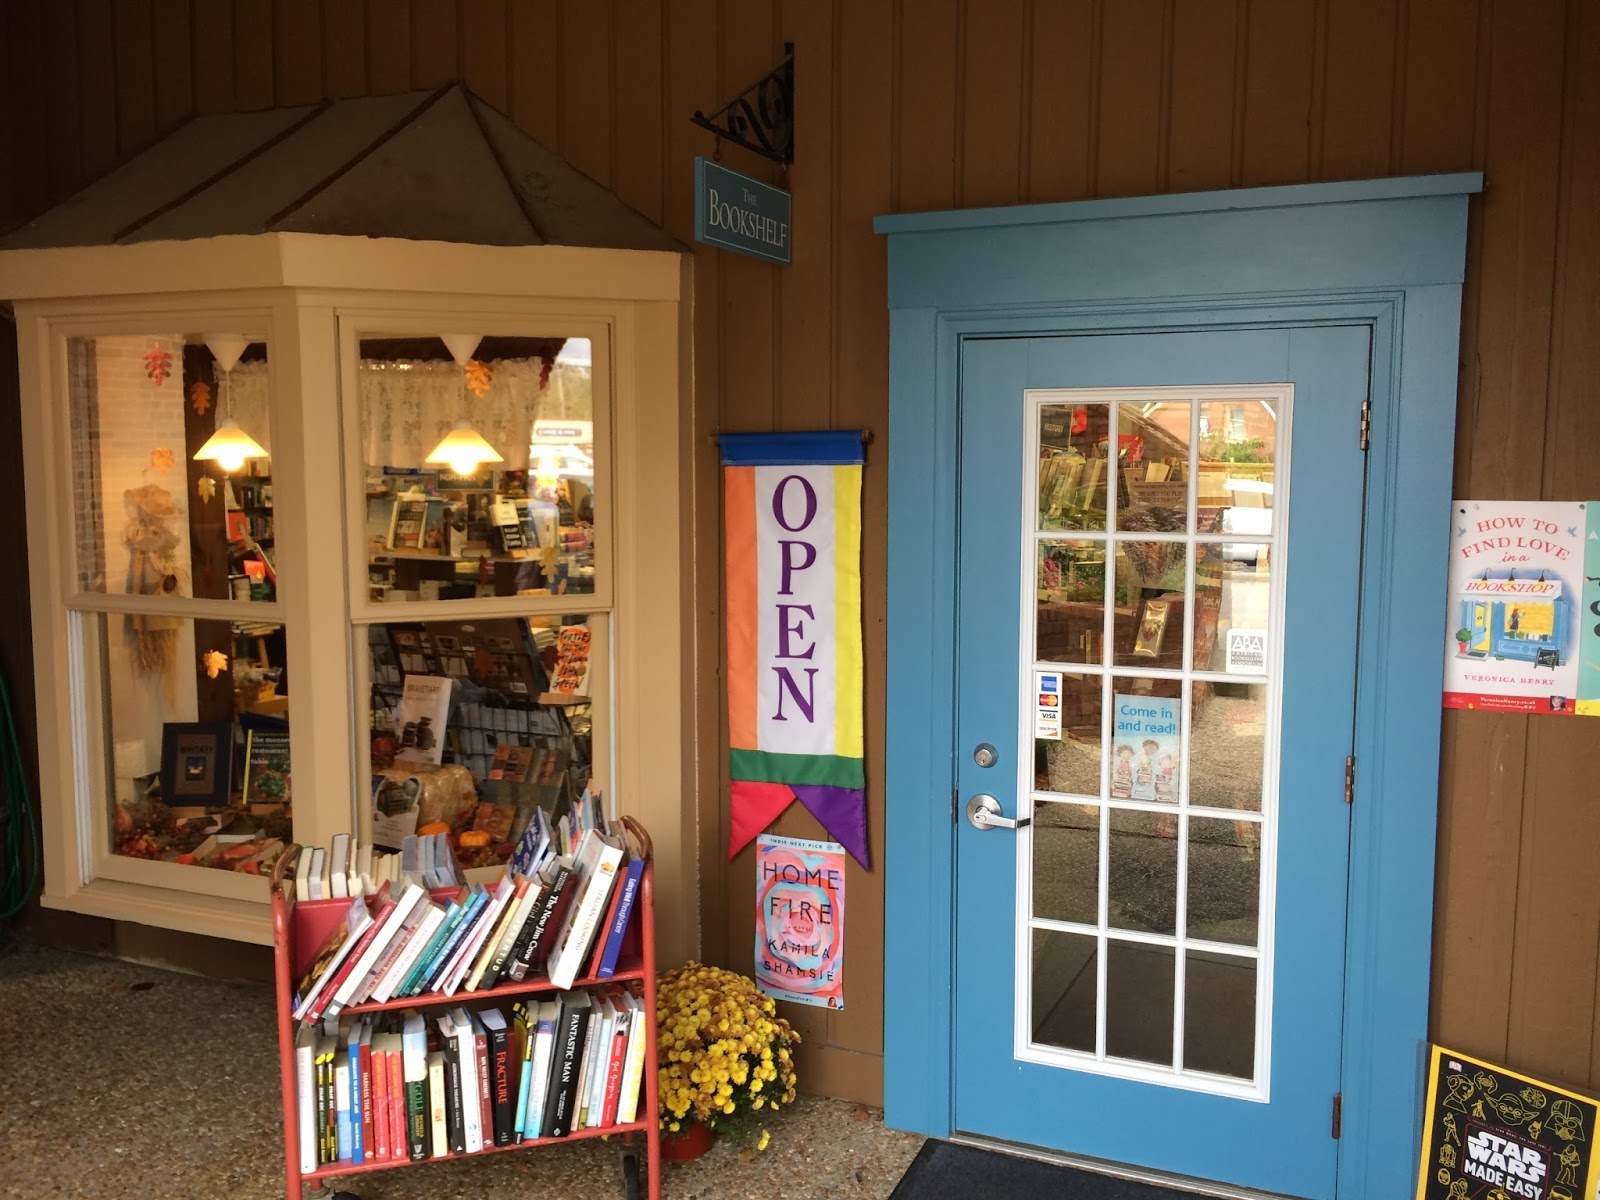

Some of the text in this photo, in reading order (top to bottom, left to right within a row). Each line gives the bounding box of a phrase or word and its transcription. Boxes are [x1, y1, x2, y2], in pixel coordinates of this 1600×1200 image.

[742, 188, 757, 206] THE
[709, 188, 788, 247] BOOKSHELF
[1044, 423, 1064, 433] HISTORY
[1476, 517, 1558, 535] HOW TO
[1461, 536, 1570, 560] FIND LOVE
[1499, 551, 1517, 563] in
[1465, 581, 1555, 593] BOOKSHOP
[771, 474, 819, 723] OPEN
[1231, 634, 1263, 651] ABA
[1463, 674, 1555, 686] VERONICA HENRY
[1120, 704, 1173, 719] Come in
[1118, 720, 1176, 735] and read!
[626, 877, 637, 892] Eating
[763, 861, 840, 891] HOME
[623, 891, 634, 902] Well
[575, 889, 604, 951] ITALIAN COOKING
[618, 901, 630, 918] Through
[770, 896, 832, 925] FIRE
[524, 895, 559, 960] The New Jim Crow
[492, 918, 521, 972] JUVENTUD
[768, 939, 830, 959] KAMILA
[763, 960, 834, 981] SHAMSIE
[561, 1013, 580, 1083] FANTASTIC MAN
[496, 1051, 508, 1105] FRACTURE
[414, 1083, 424, 1112] GOLF
[1467, 1141, 1546, 1183] WARS
[1468, 1131, 1547, 1171] STAR
[1464, 1159, 1543, 1200] MADE EASY
